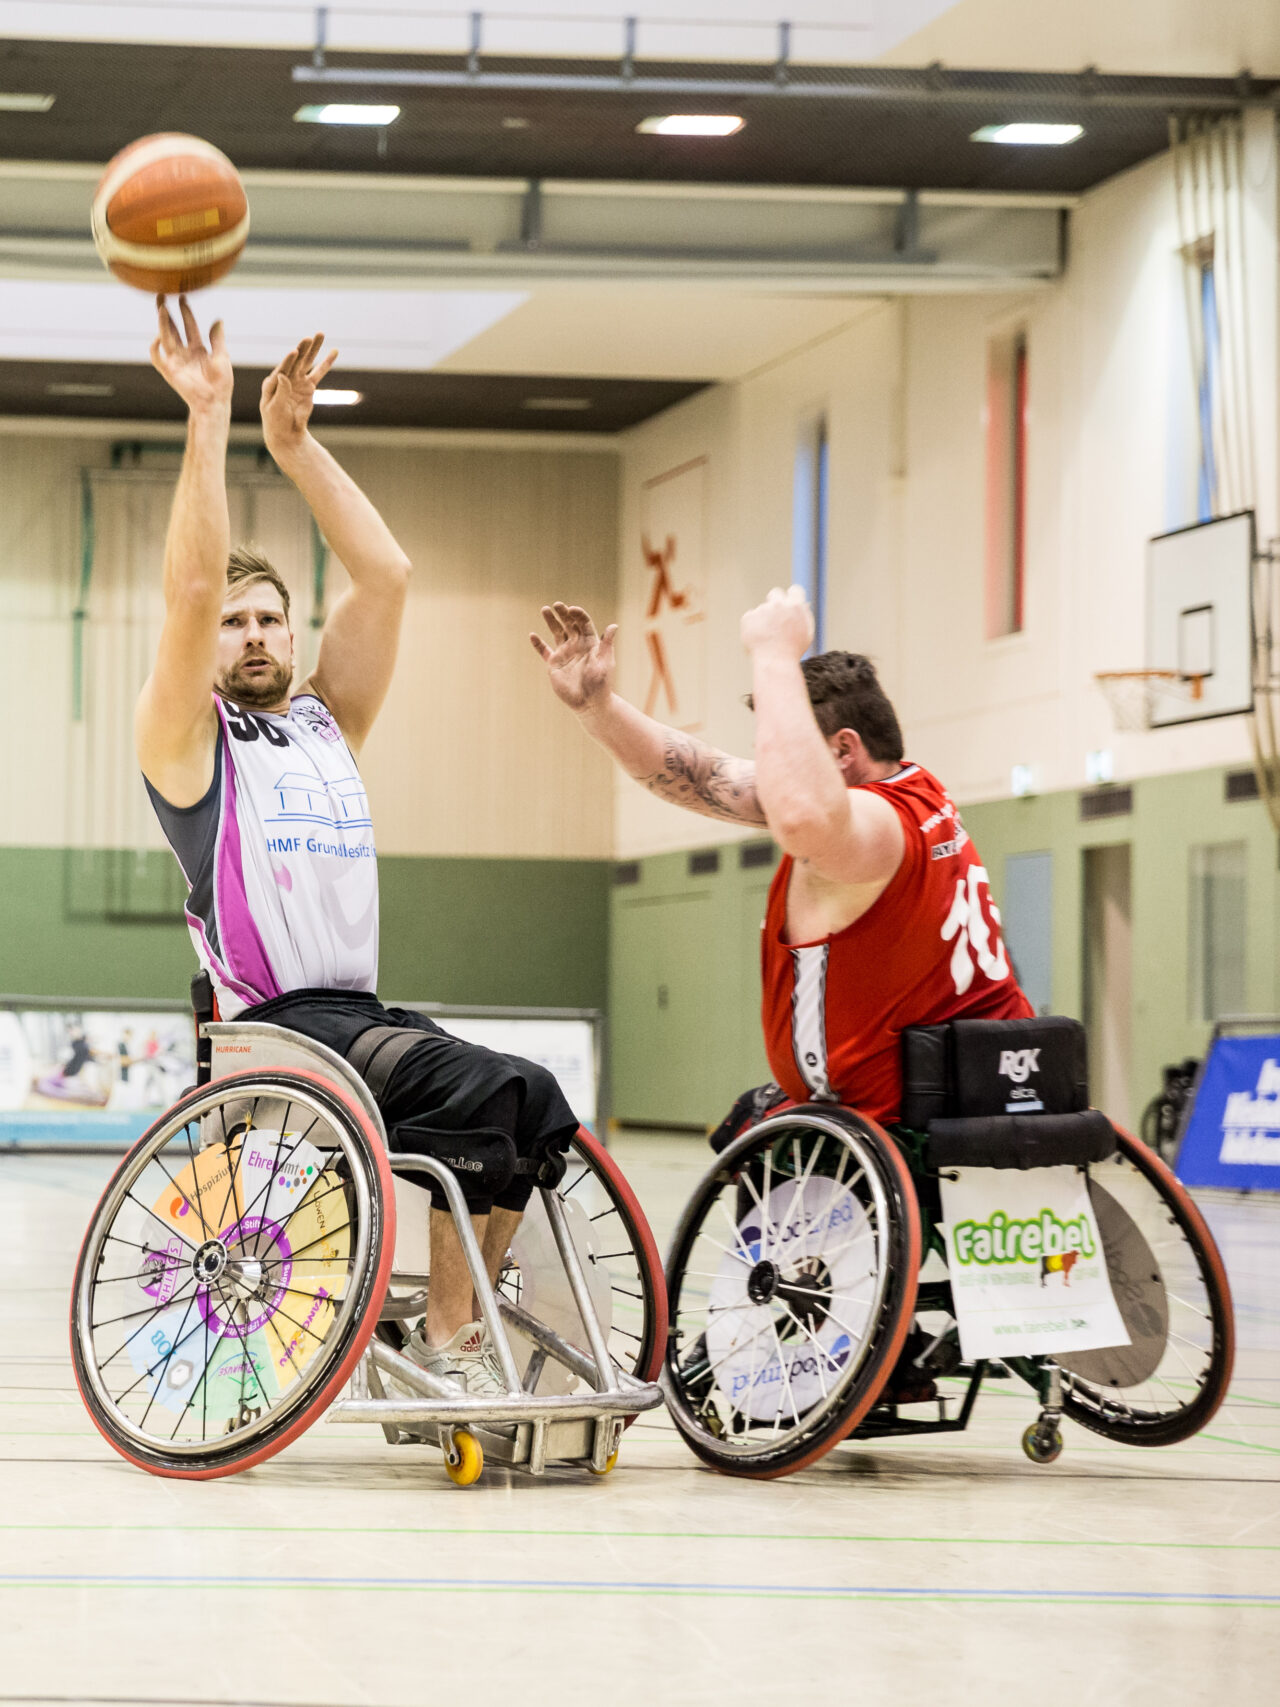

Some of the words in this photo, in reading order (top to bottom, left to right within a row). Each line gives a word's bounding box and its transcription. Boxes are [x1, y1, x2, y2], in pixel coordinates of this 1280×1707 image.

[266, 838, 301, 853] HMF
[215, 1045, 252, 1054] HURRICANE
[190, 1161, 236, 1201] Hospizium
[953, 1207, 1096, 1267] Fairebel
[160, 1245, 179, 1303] RHINOS
